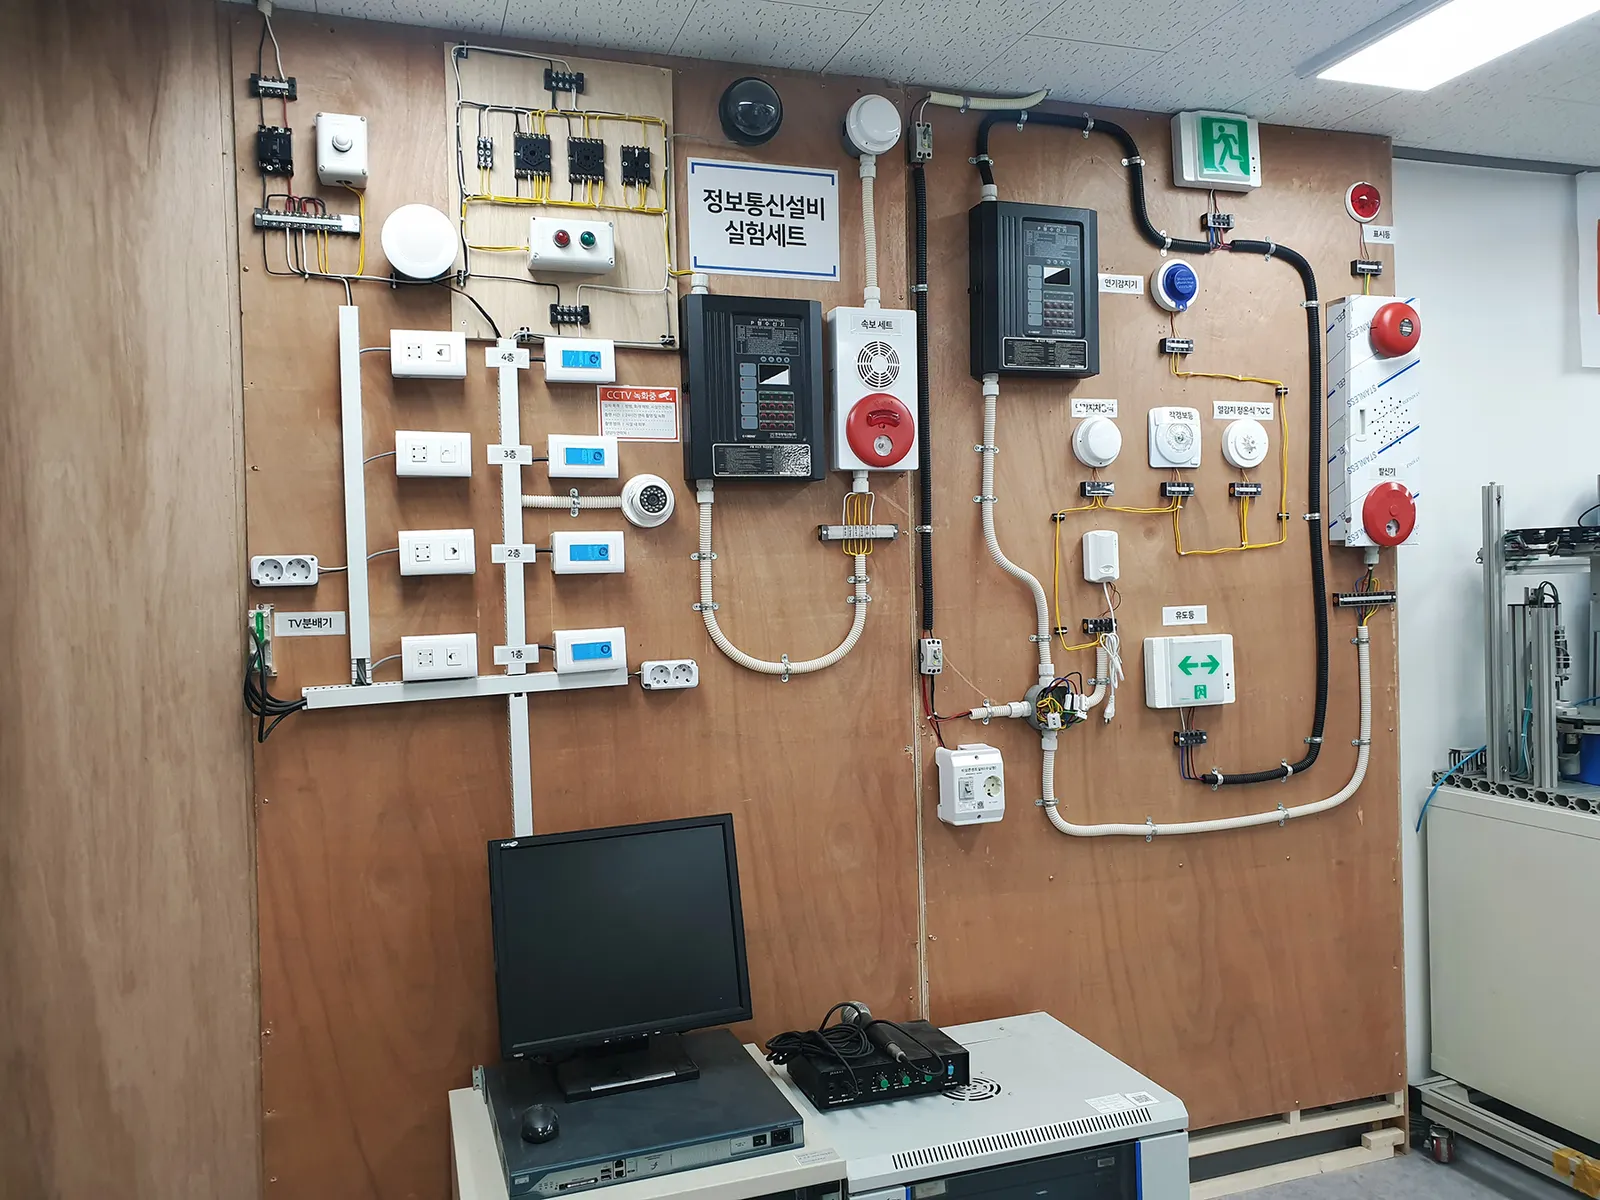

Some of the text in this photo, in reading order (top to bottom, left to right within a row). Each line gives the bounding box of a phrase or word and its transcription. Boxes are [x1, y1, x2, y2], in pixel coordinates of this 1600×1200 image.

[703, 188, 825, 220] 정보통신설비
[724, 220, 807, 247] 실험세트
[1373, 230, 1391, 239] 표시등
[1104, 278, 1138, 289] 연기감지기
[501, 353, 515, 362] 4층
[607, 390, 657, 401] CCTV 녹화중
[1346, 384, 1377, 408] STAINLESS
[503, 450, 517, 460] 3층
[1346, 450, 1378, 475] STAINLESS
[1378, 467, 1396, 477] 발신기
[507, 548, 521, 558] 2층
[1175, 610, 1195, 620] 유도등
[288, 617, 332, 629] TV분배기
[510, 649, 524, 660] 1층
